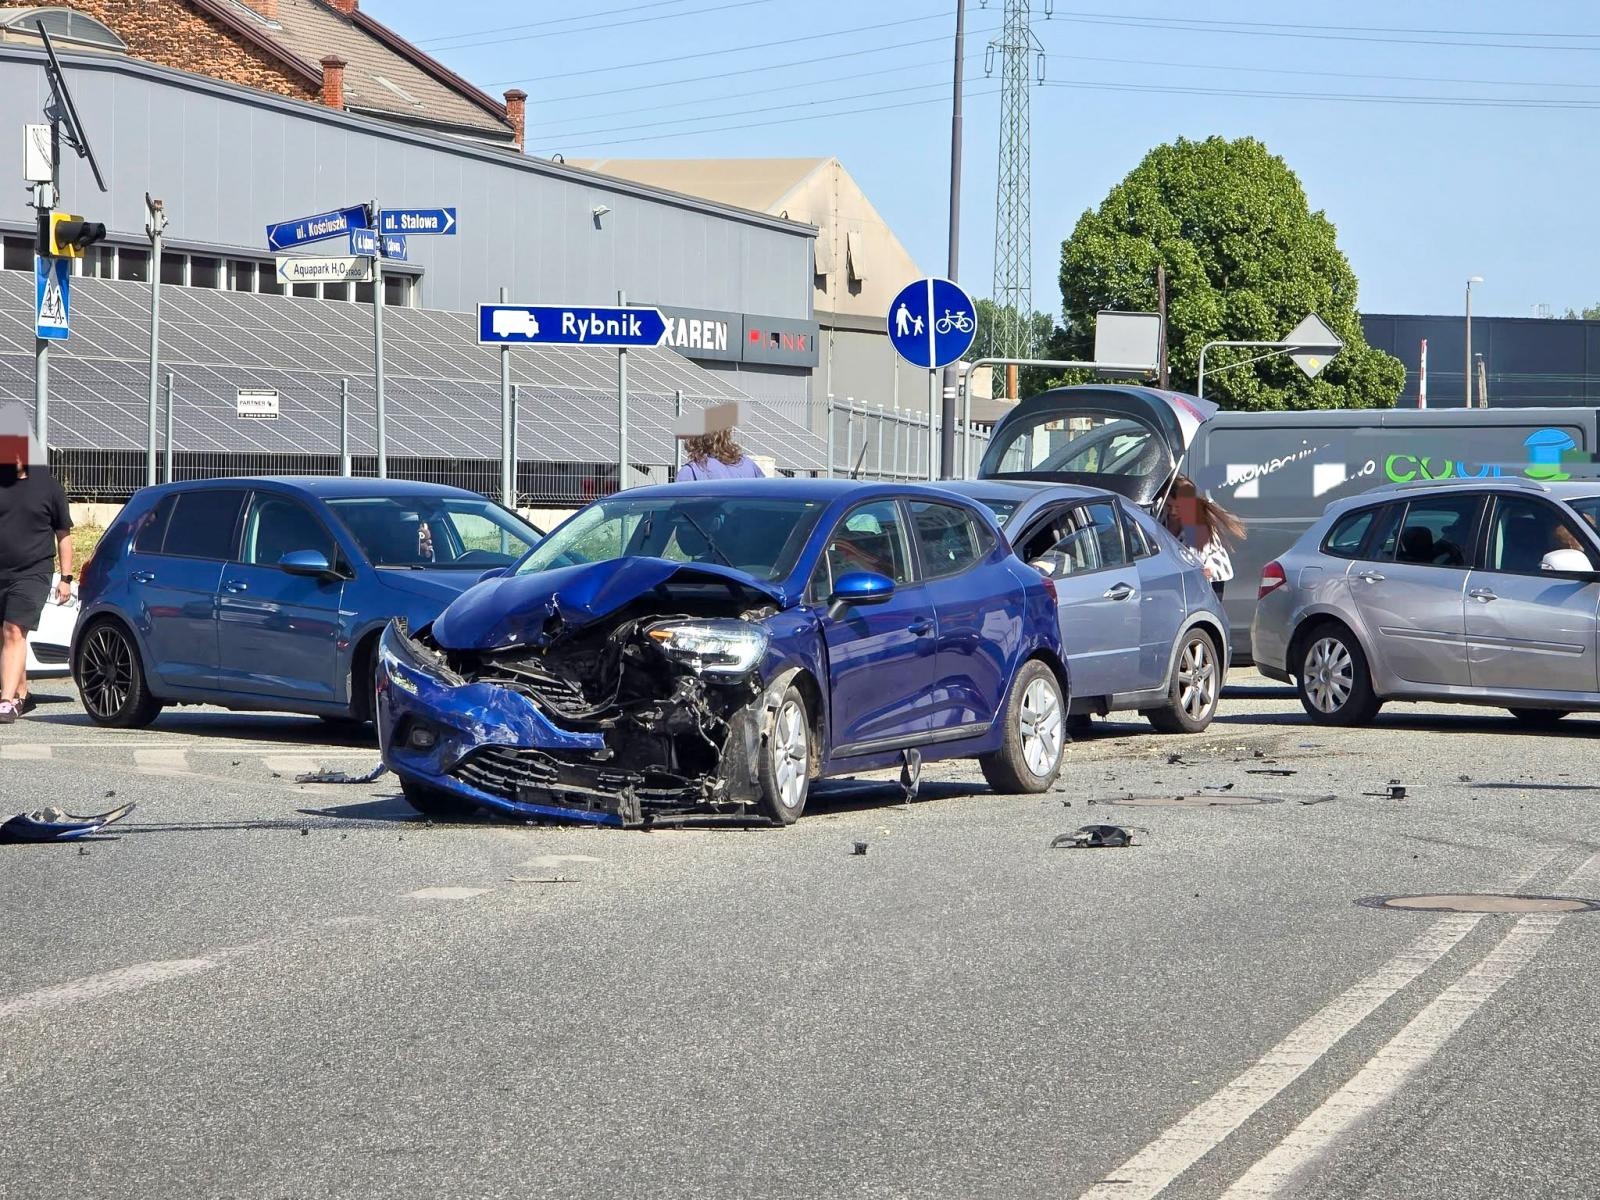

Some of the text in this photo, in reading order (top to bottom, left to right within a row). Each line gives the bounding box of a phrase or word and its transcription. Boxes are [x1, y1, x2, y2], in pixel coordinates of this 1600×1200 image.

[296, 215, 347, 239] ul. Kościuszki
[385, 213, 438, 229] ul. Stalowa
[294, 262, 329, 277] Aquapark
[562, 312, 642, 341] Rybnik
